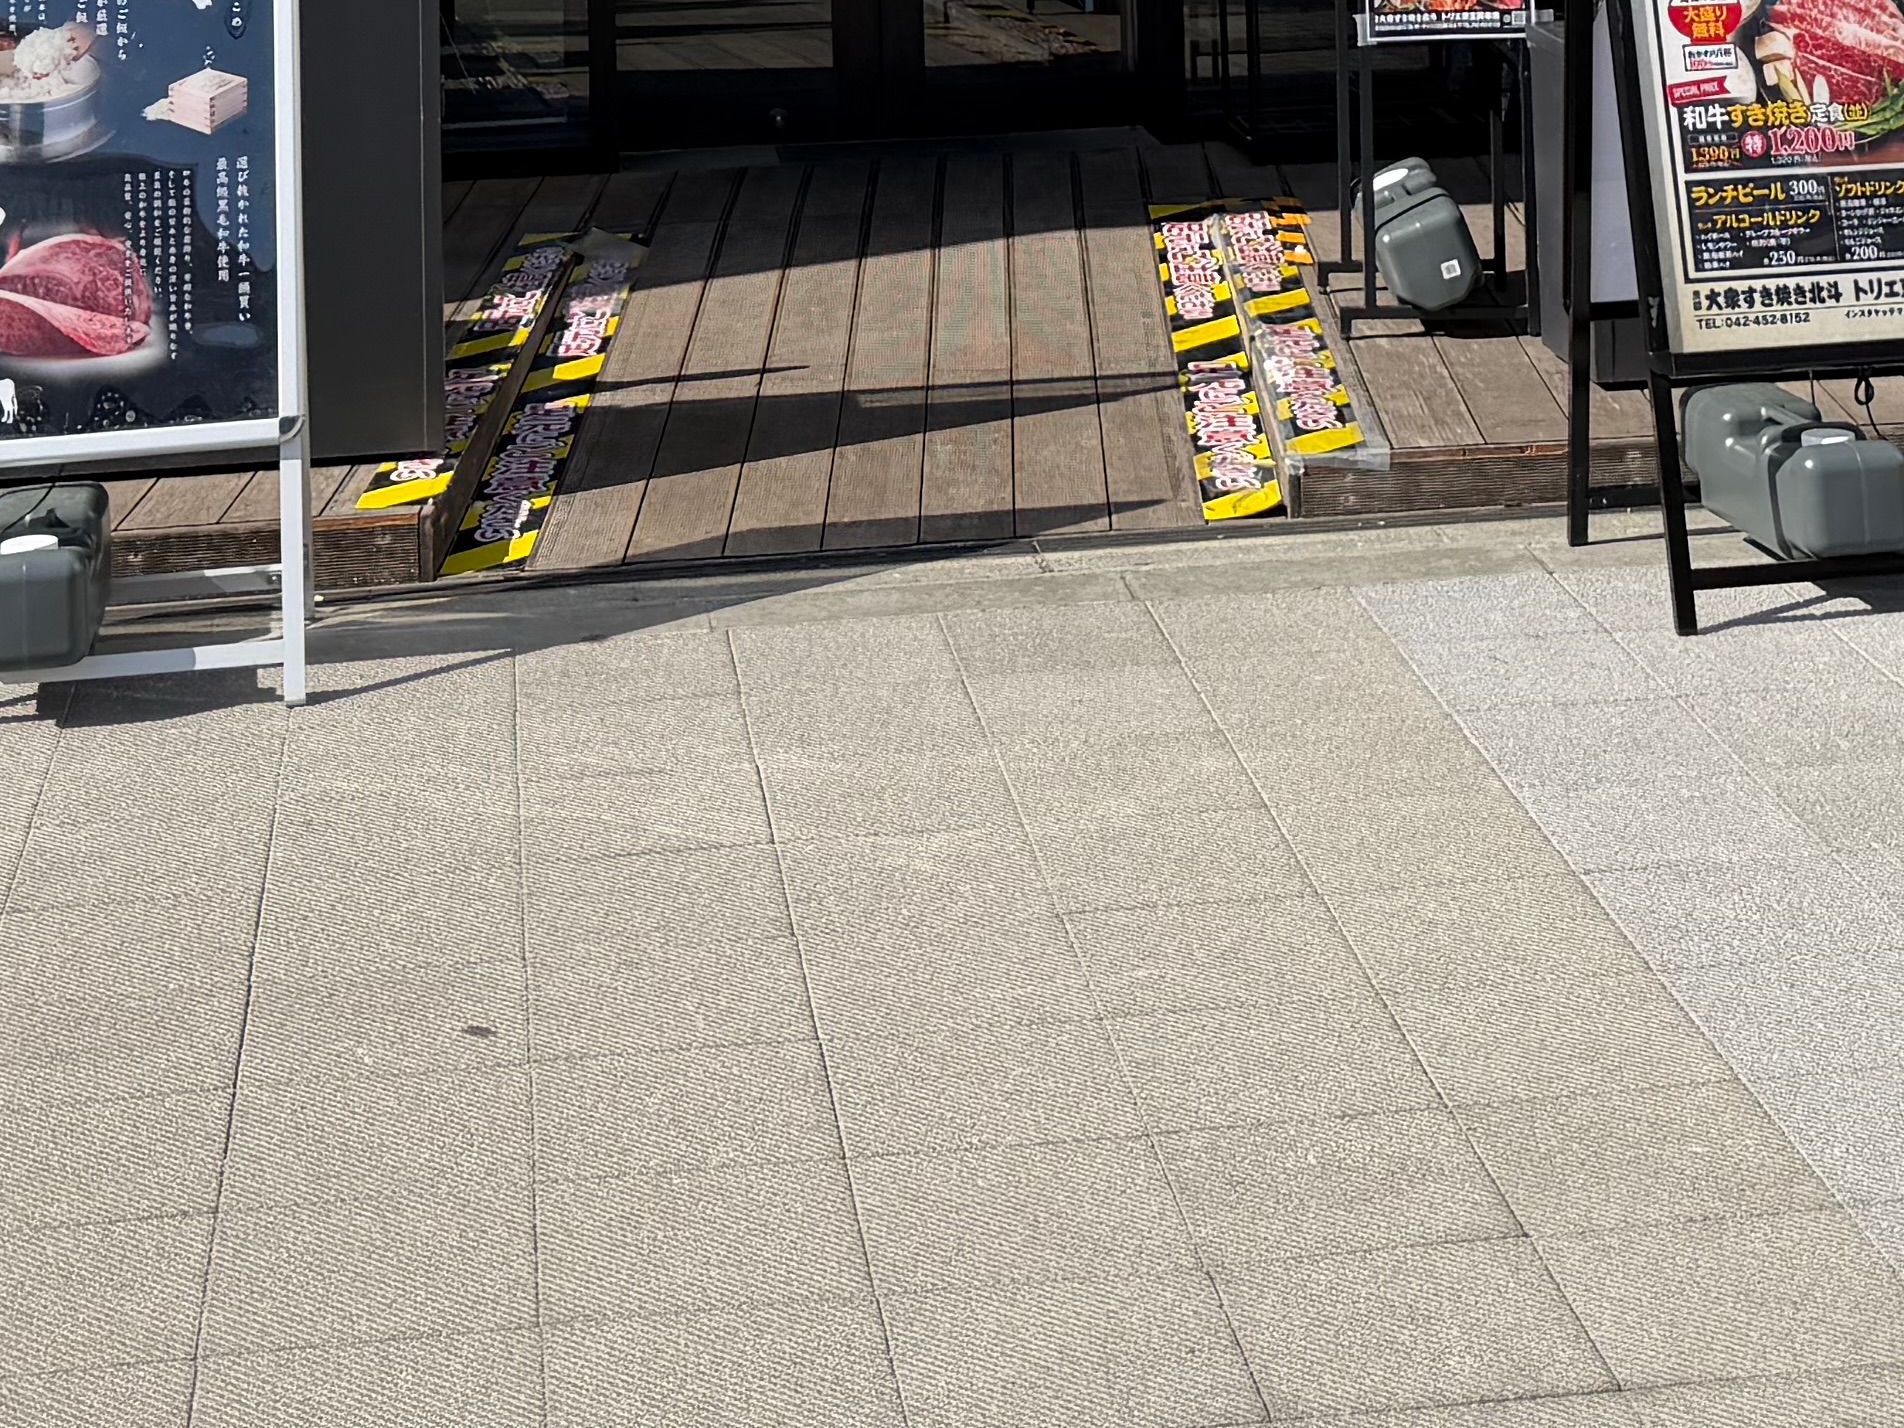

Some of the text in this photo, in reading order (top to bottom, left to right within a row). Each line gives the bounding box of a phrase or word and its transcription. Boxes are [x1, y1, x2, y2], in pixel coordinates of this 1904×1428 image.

[229, 0, 244, 29] こめ
[1683, 5, 1728, 23] 大盛り
[1692, 22, 1726, 39] 無料
[1691, 182, 1786, 206] ランチビール
[1713, 209, 1821, 229] アルコールドリンク
[1705, 281, 1844, 312] 大衆すき焼き北斗
